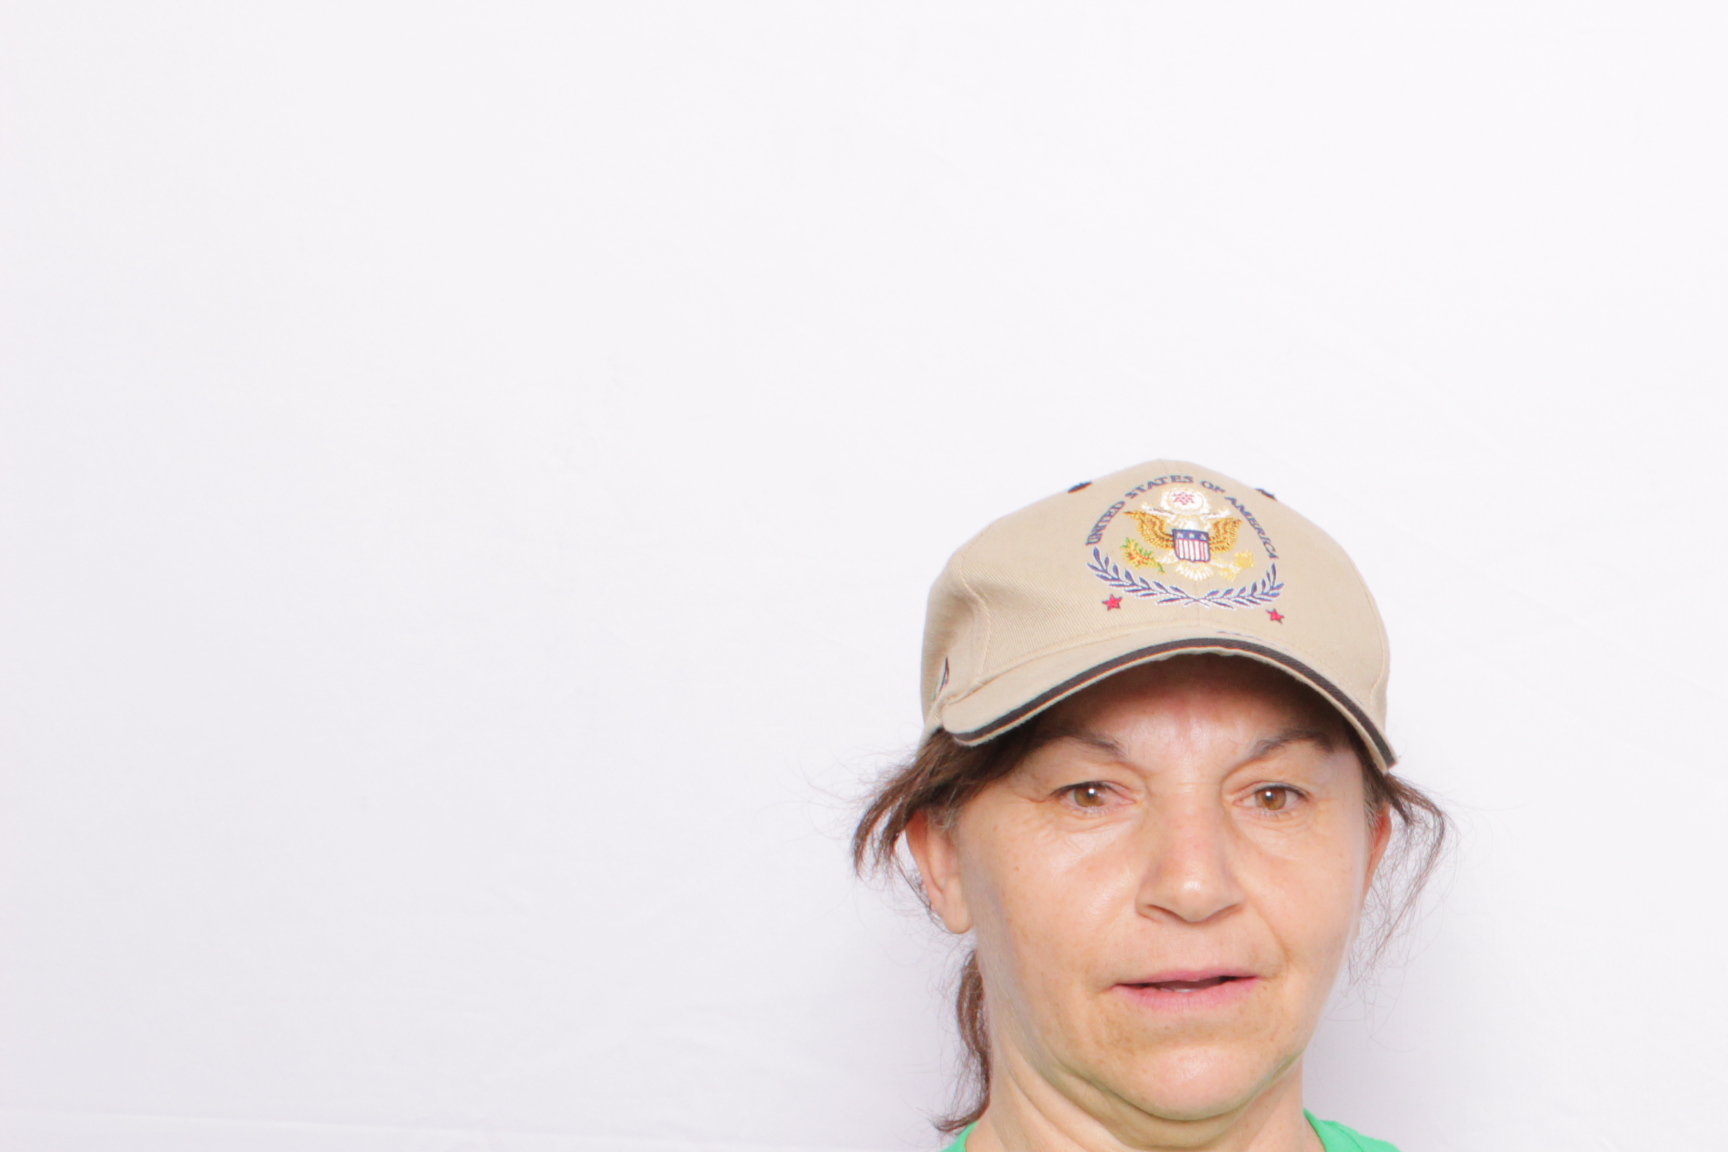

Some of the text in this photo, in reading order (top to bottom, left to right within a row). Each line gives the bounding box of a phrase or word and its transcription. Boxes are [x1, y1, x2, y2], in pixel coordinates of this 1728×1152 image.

[1085, 474, 1280, 560] UNITED STATES OF AMERICA
